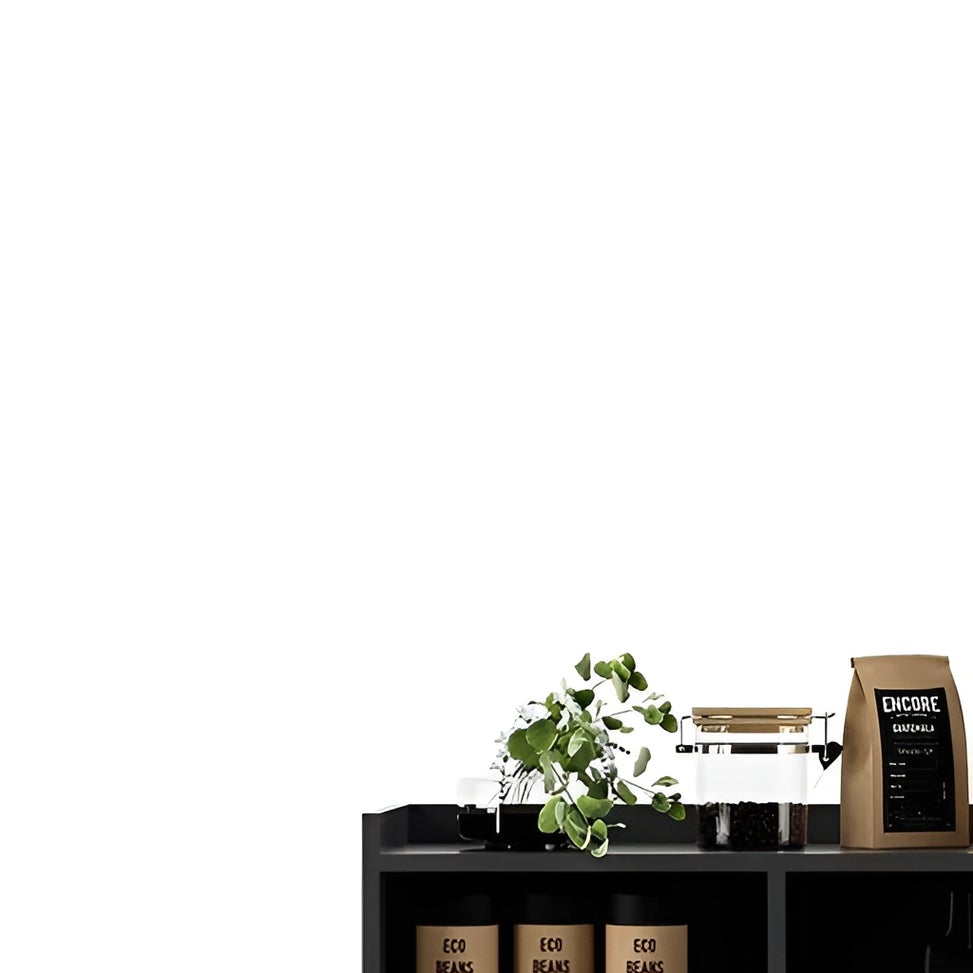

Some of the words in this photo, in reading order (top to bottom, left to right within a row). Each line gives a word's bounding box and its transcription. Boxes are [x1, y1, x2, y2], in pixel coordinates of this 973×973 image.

[882, 695, 941, 713] ENCORE
[443, 938, 466, 954] ECO
[540, 937, 563, 953] ECO
[633, 938, 656, 953] ECO
[532, 959, 570, 973] BEANS
